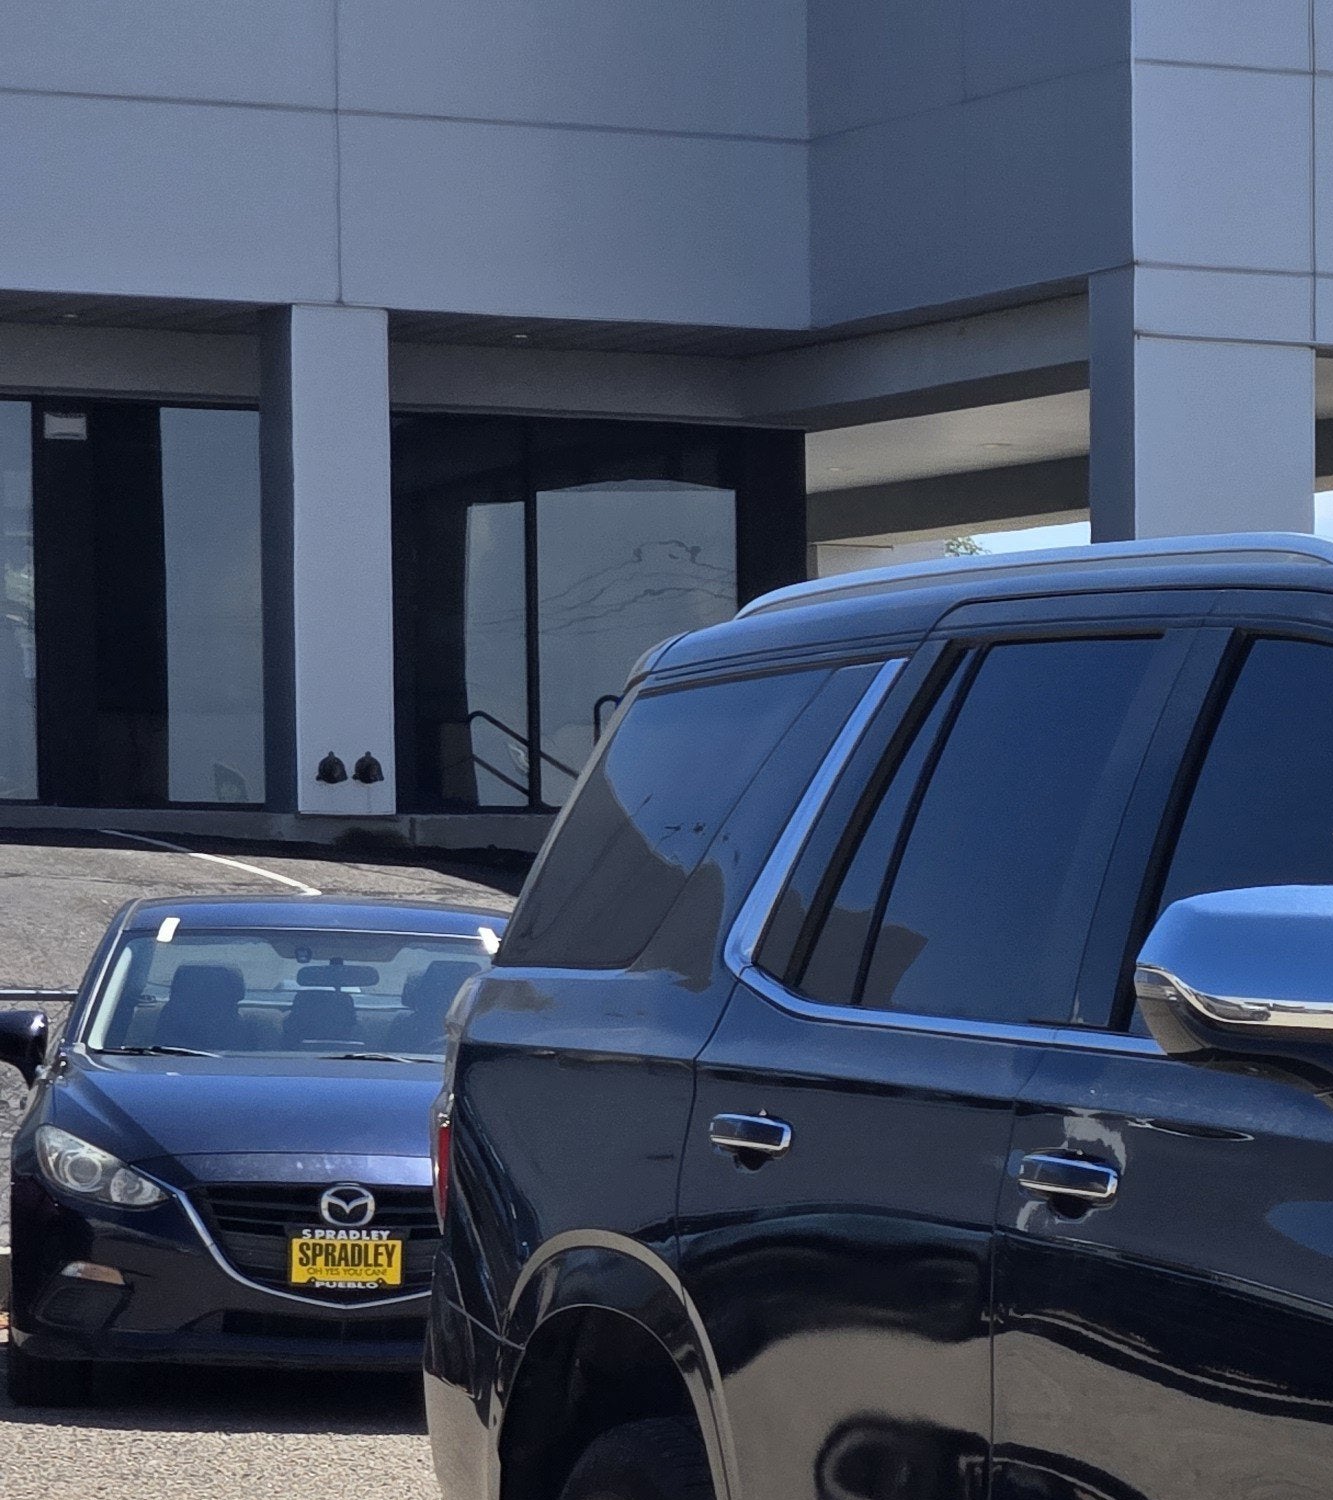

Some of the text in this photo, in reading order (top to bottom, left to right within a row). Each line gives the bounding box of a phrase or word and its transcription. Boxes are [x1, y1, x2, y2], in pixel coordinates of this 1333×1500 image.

[302, 1229, 390, 1240] SPRADLEY
[298, 1242, 396, 1268] SPRADLEY
[343, 1268, 362, 1276] YOU
[315, 1281, 378, 1289] PUEBLO
